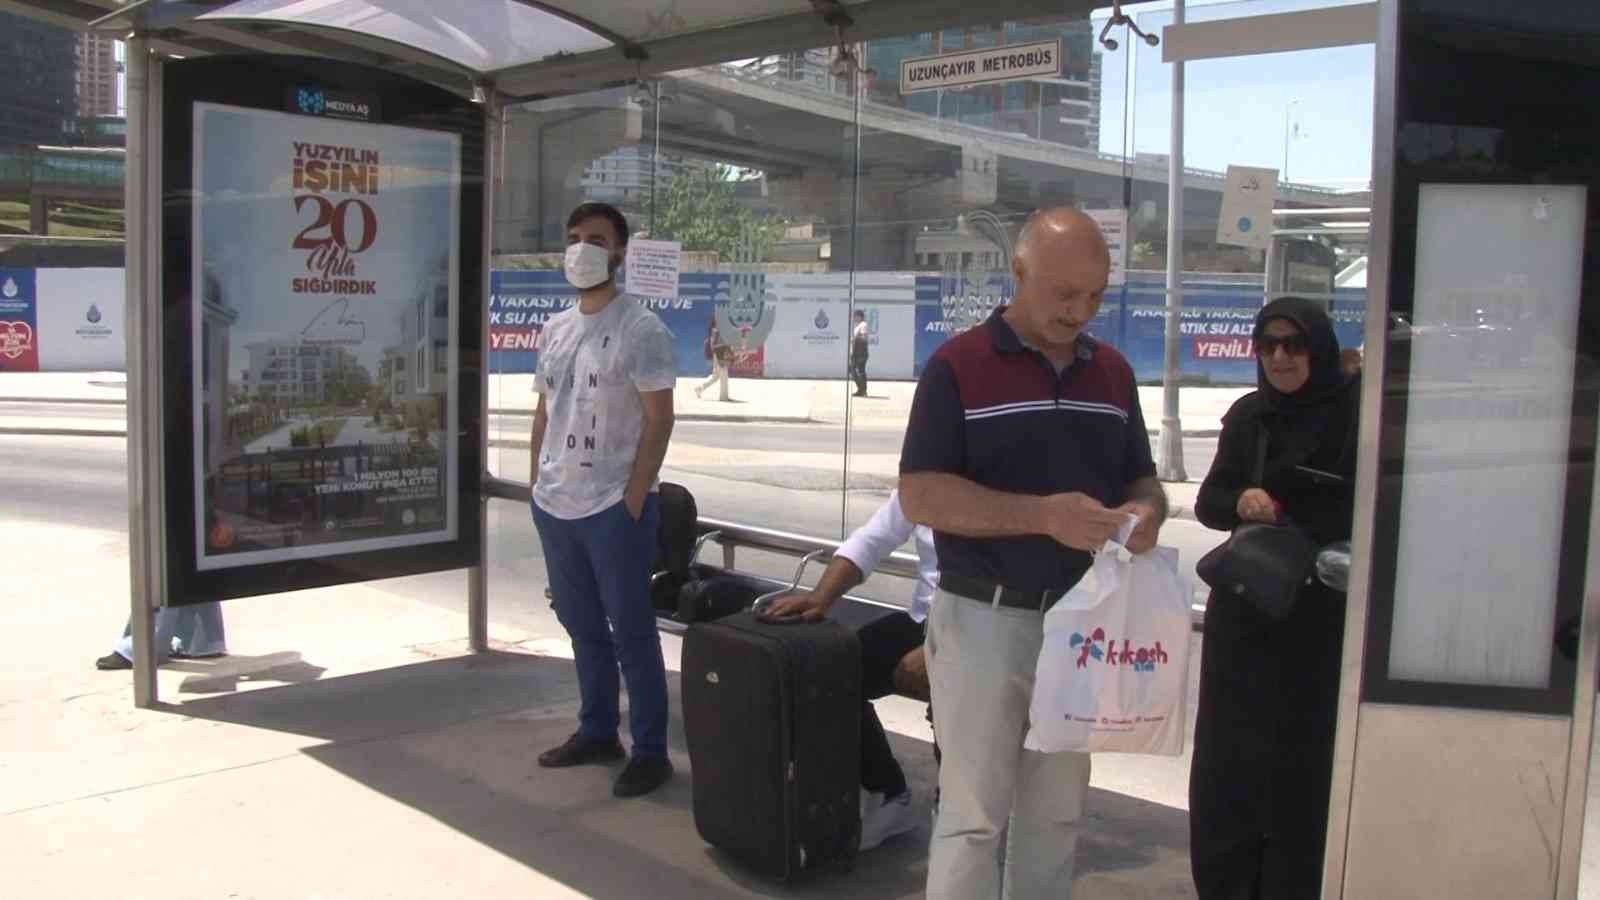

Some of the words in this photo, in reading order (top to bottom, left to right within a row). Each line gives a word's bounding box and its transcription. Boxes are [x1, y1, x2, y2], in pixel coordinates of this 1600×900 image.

[908, 60, 976, 82] UZUNÇAYIR
[292, 195, 378, 253] 20
[504, 312, 526, 325] SU
[1209, 322, 1229, 335] SU
[1230, 322, 1257, 336] ALT
[1197, 339, 1257, 358] YENİLİ
[588, 373, 598, 388] N
[567, 434, 576, 449] O
[584, 436, 595, 450] N
